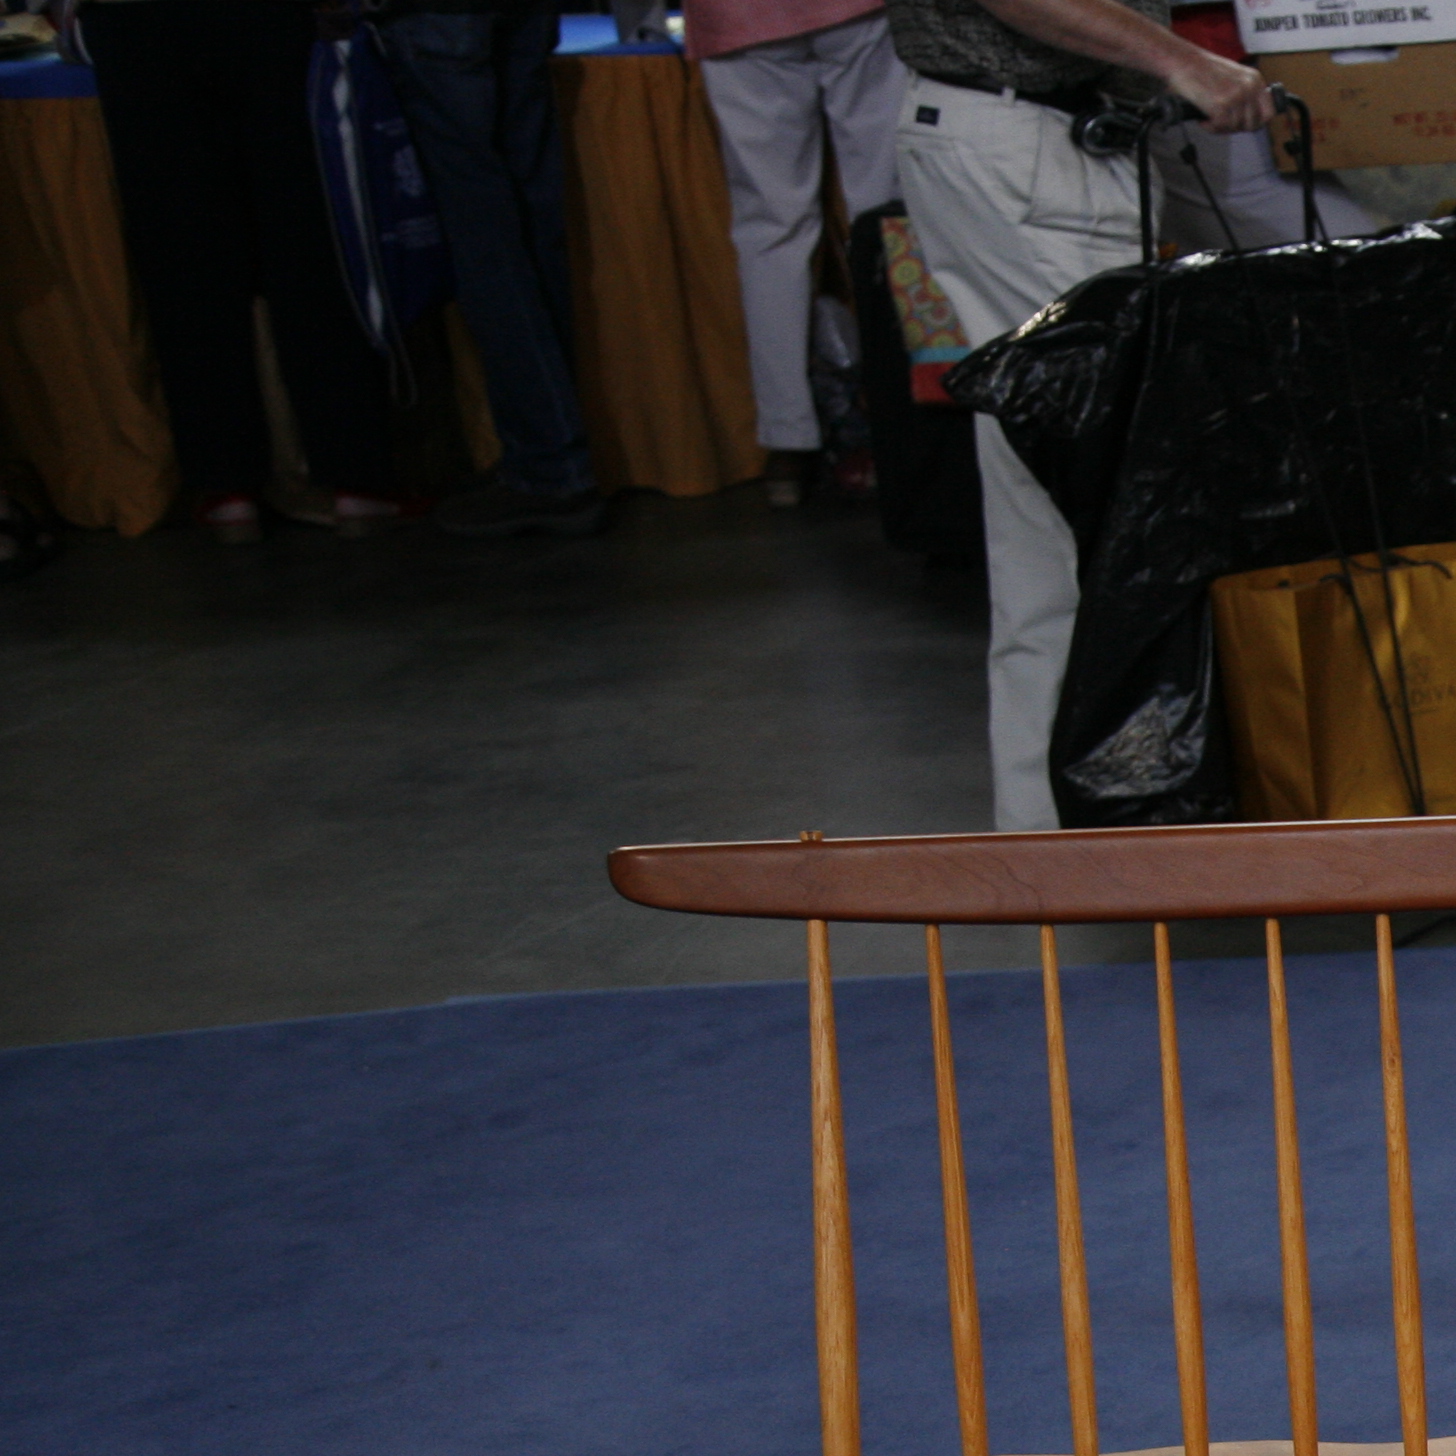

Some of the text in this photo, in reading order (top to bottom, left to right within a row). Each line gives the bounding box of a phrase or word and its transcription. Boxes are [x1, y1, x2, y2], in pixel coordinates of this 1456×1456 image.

[1254, 15, 1299, 32] JUNIPER
[1302, 11, 1349, 29] TOMATO
[1353, 7, 1407, 25] GROWERS
